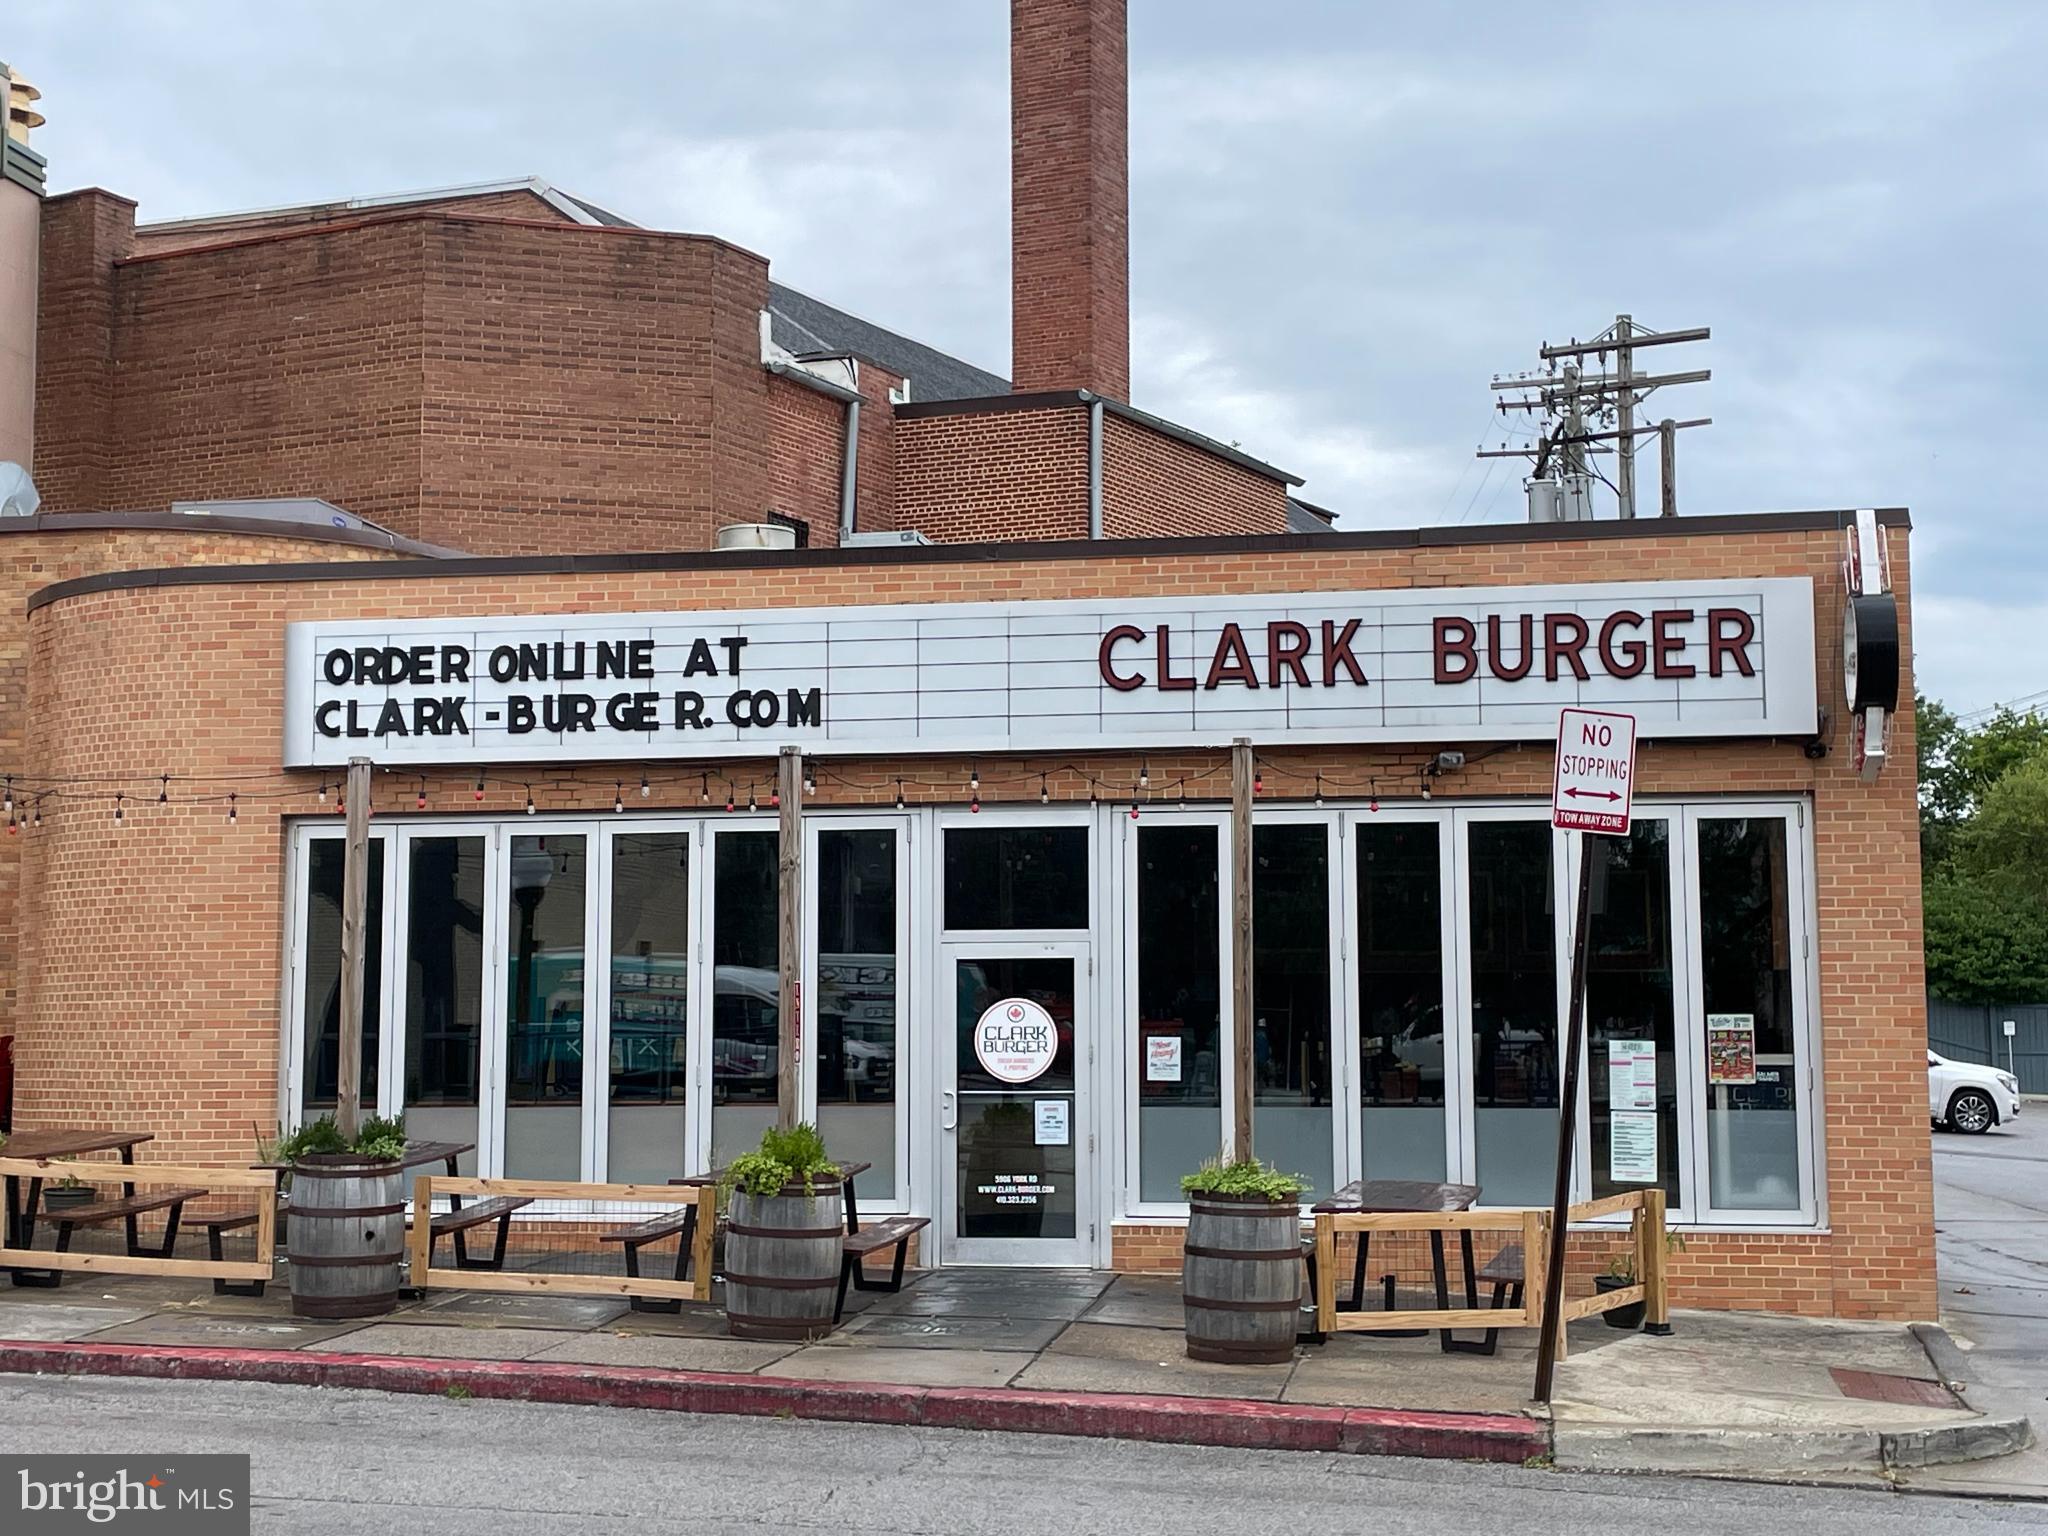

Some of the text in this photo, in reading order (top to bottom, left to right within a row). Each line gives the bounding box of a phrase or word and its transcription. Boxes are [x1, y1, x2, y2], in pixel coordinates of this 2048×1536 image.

[323, 636, 748, 685] ORDER ONLINE AT
[1099, 607, 1756, 692] CLARK BURGER
[1583, 723, 1612, 747] NO
[1563, 755, 1627, 780] STOPPING
[1560, 811, 1622, 827] TOW AWAY ZONE
[984, 1026, 1047, 1040] CLARK
[984, 1041, 1048, 1054] BURGER
